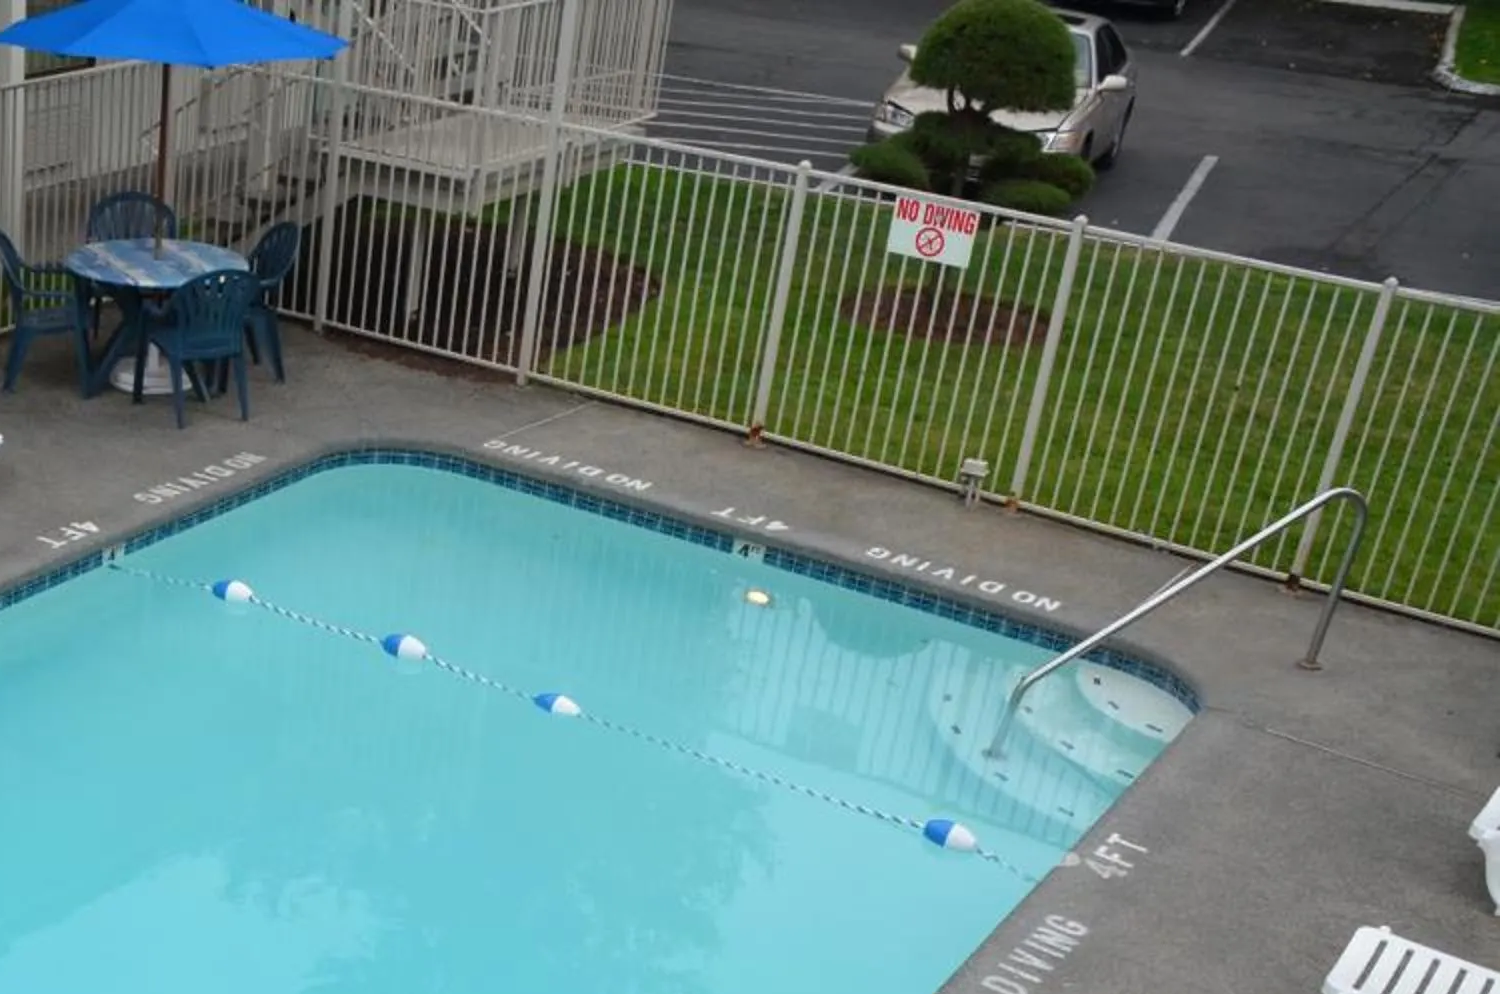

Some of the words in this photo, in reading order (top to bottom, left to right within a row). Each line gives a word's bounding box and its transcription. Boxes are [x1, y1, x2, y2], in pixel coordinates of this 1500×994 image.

[897, 197, 920, 222] NO
[923, 203, 977, 235] DIVING
[223, 451, 267, 470] NO
[483, 439, 605, 477] DIVING
[133, 464, 235, 504] DIVING
[605, 473, 652, 491] NO
[36, 520, 100, 549] 4FT
[709, 507, 789, 531] 4FT
[865, 547, 1006, 594] DIVING
[1011, 590, 1062, 613] NO
[1085, 832, 1148, 879] 4FT
